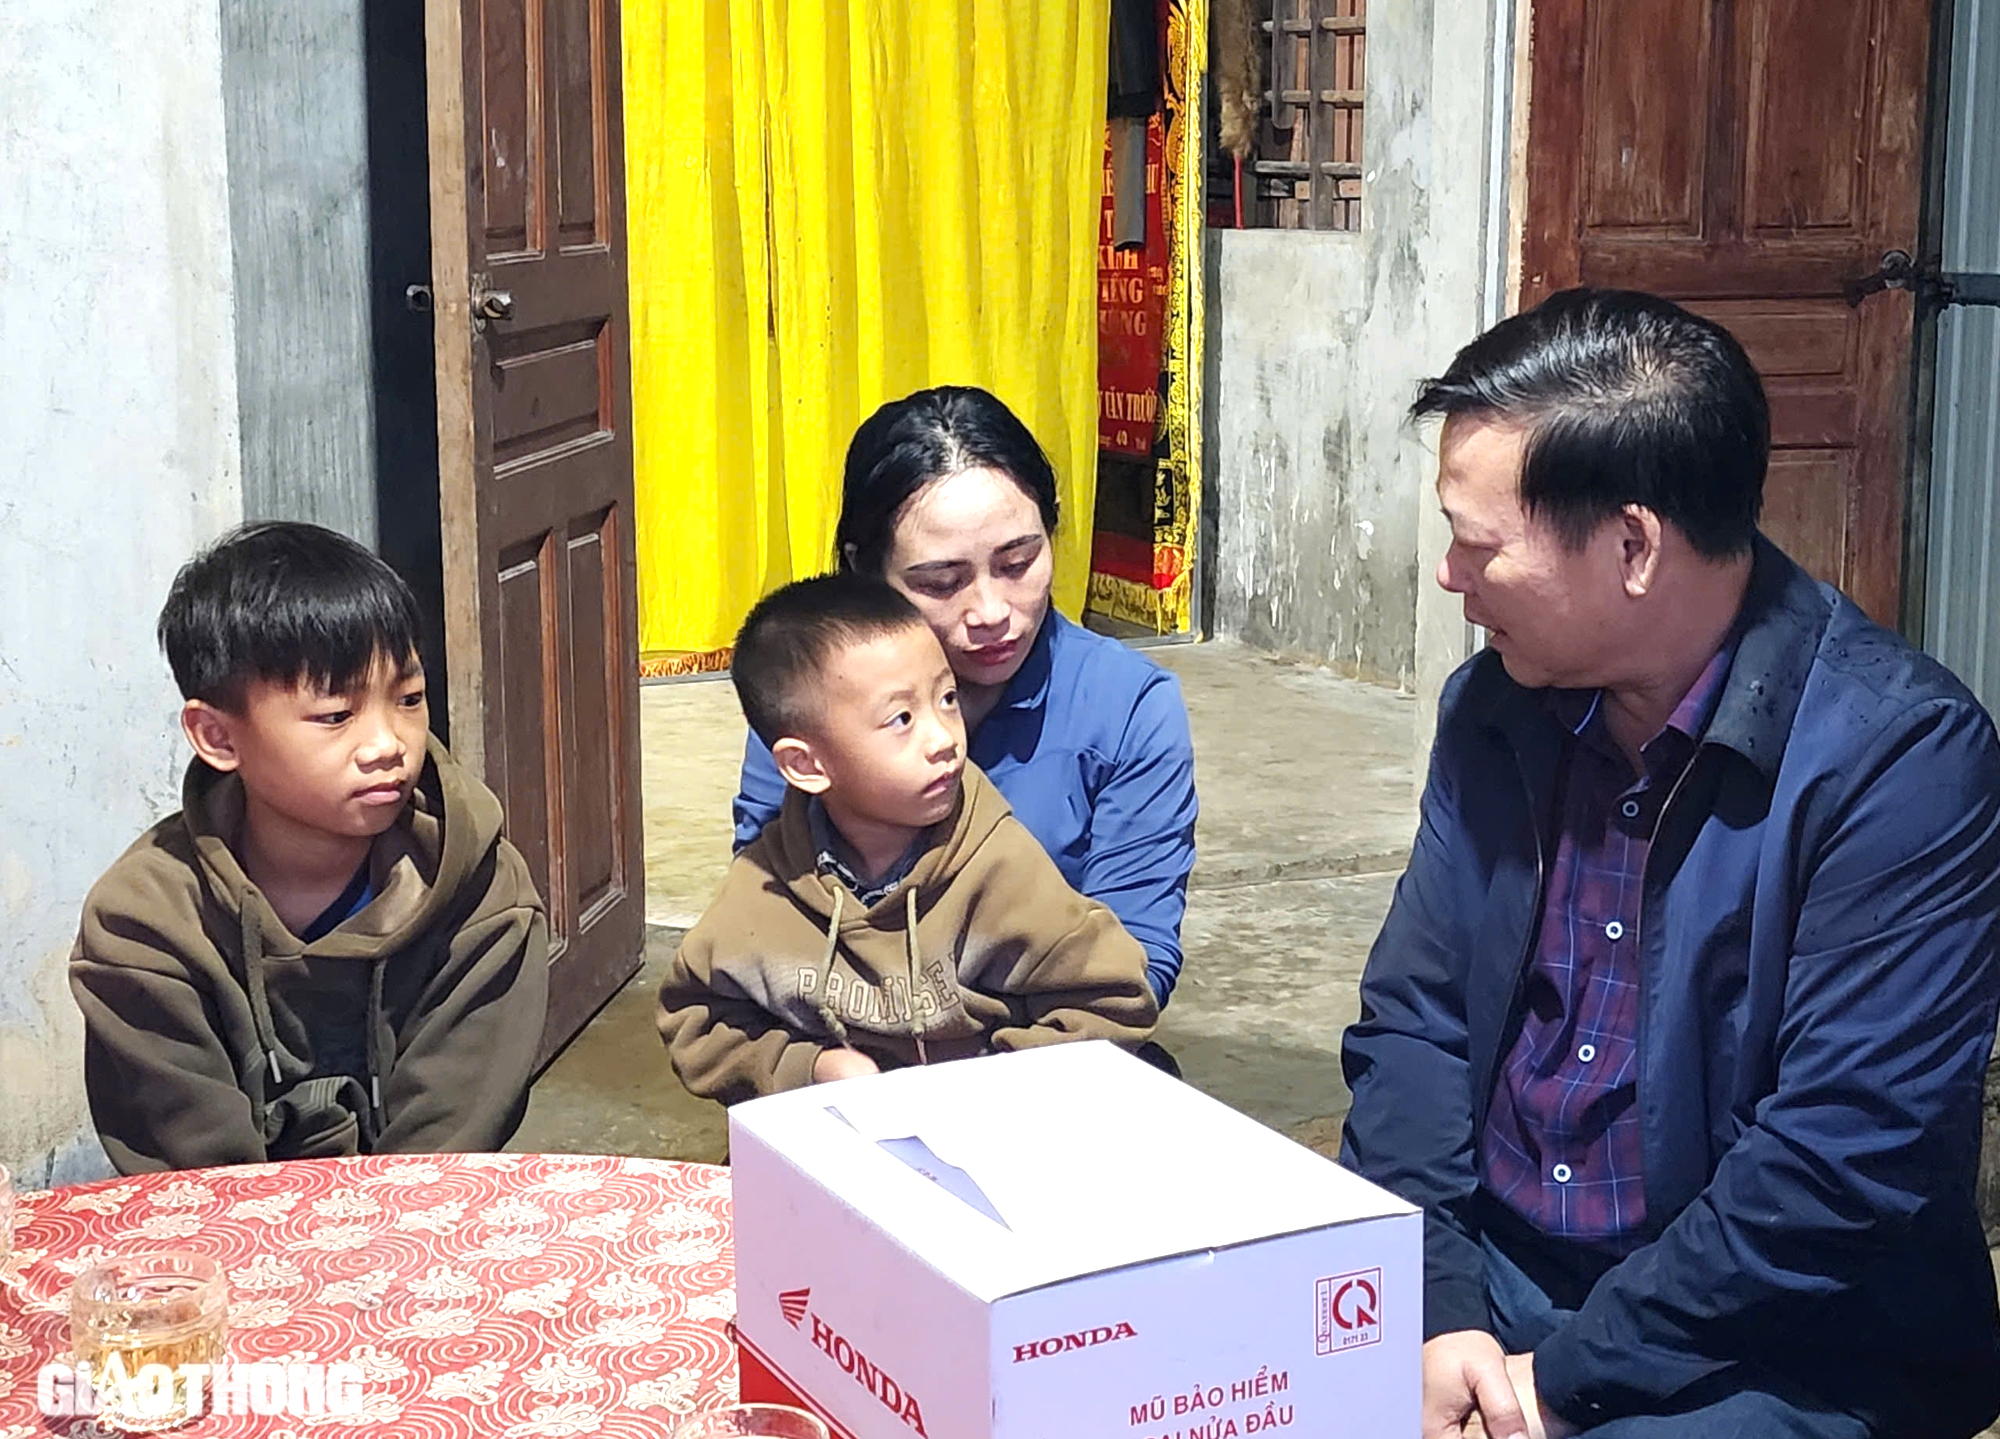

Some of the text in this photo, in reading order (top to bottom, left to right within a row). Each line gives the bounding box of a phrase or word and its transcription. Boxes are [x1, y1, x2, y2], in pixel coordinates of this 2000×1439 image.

[1013, 1321, 1138, 1364] HONDA
[811, 1312, 928, 1439] HONDA
[1130, 1365, 1289, 1426] MŨ BẢO HIỂM
[1246, 1401, 1293, 1434] ĐẦU
